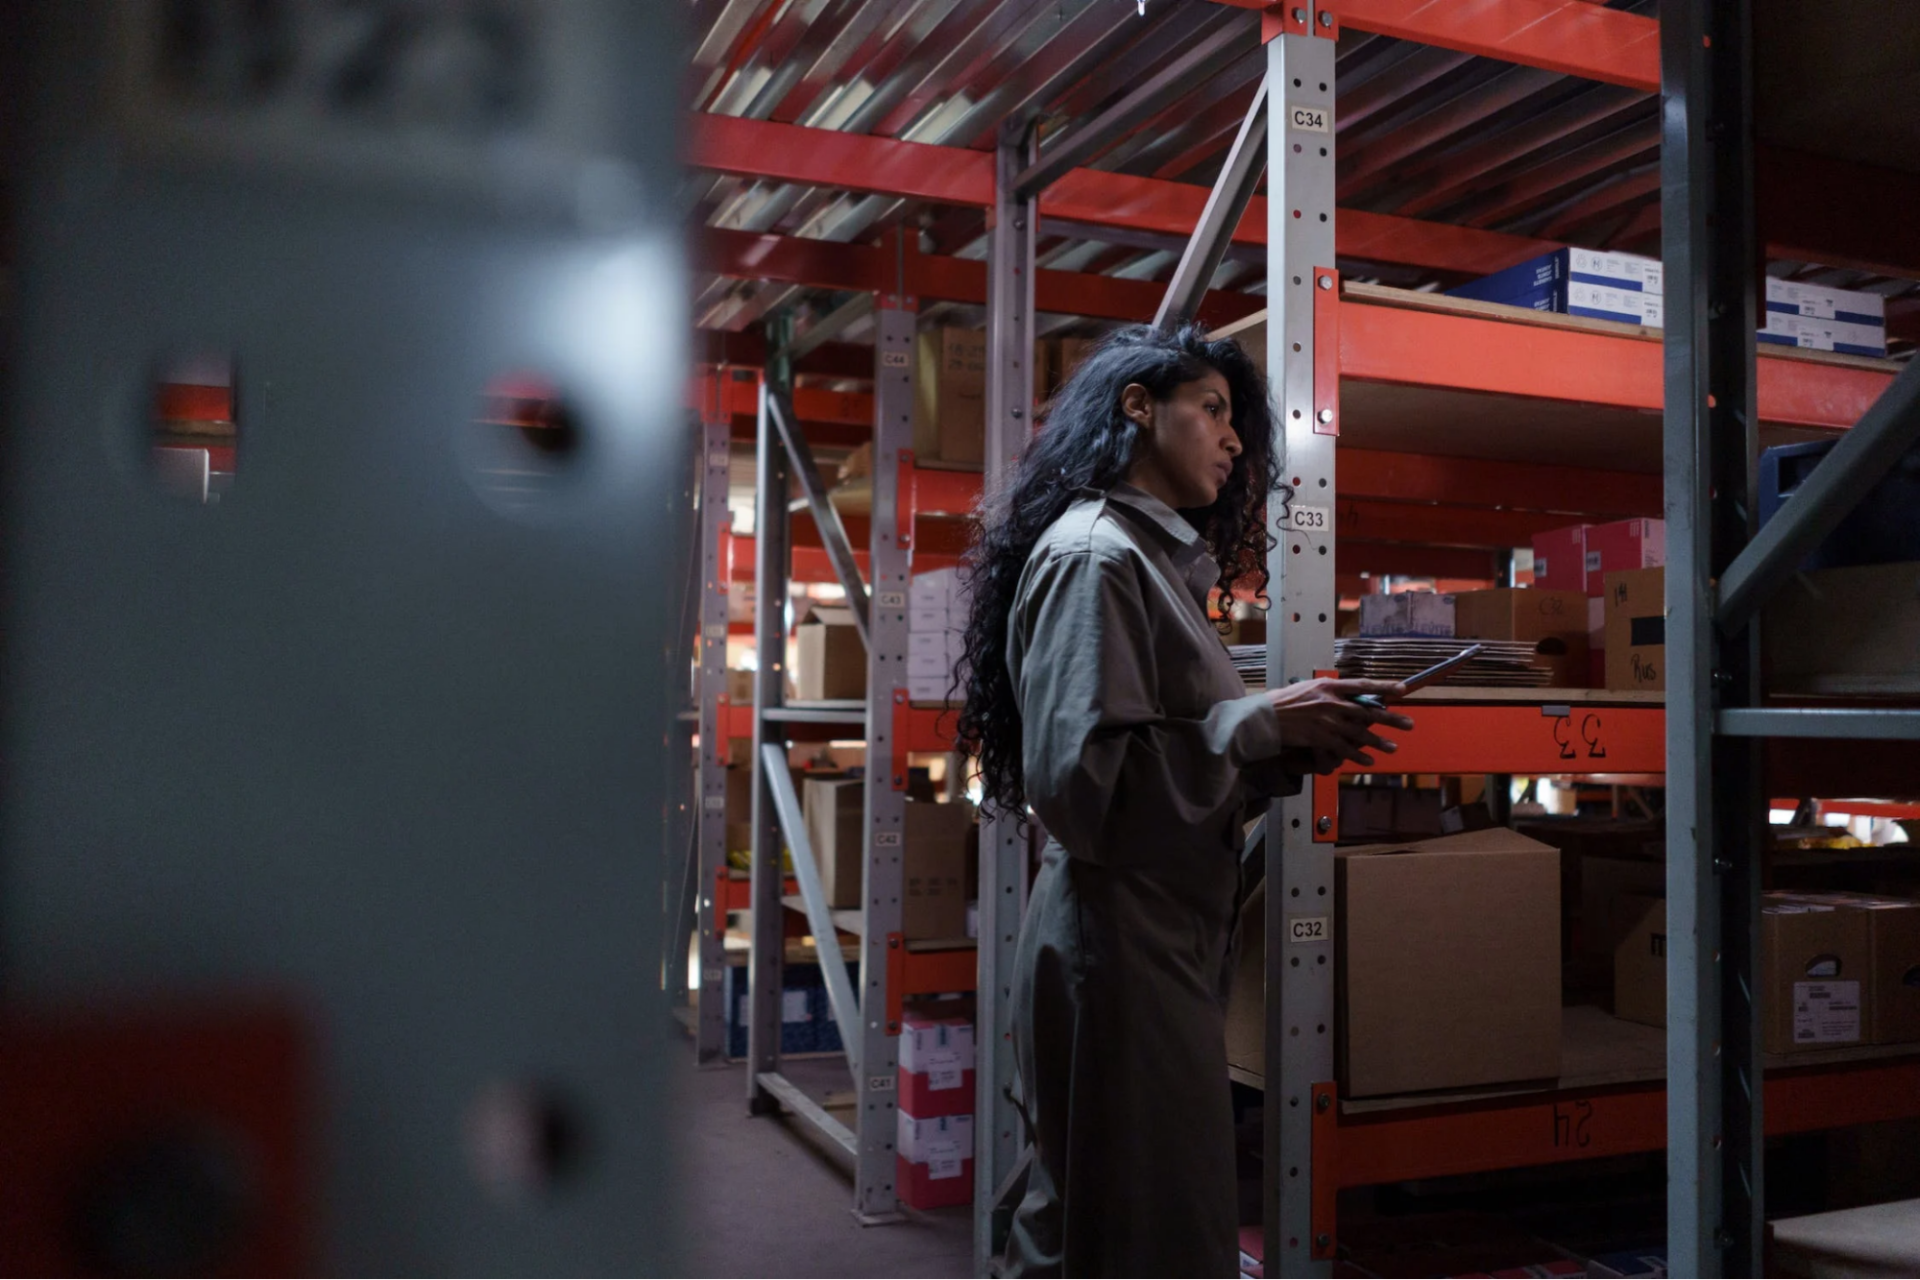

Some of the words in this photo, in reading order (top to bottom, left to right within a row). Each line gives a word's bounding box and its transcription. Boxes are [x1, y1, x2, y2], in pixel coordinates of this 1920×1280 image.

[1294, 110, 1323, 128] C34
[885, 354, 904, 364] C44
[1294, 511, 1324, 527] C33
[877, 834, 897, 845] C42
[1293, 921, 1322, 938] C32
[871, 1078, 890, 1089] C41
